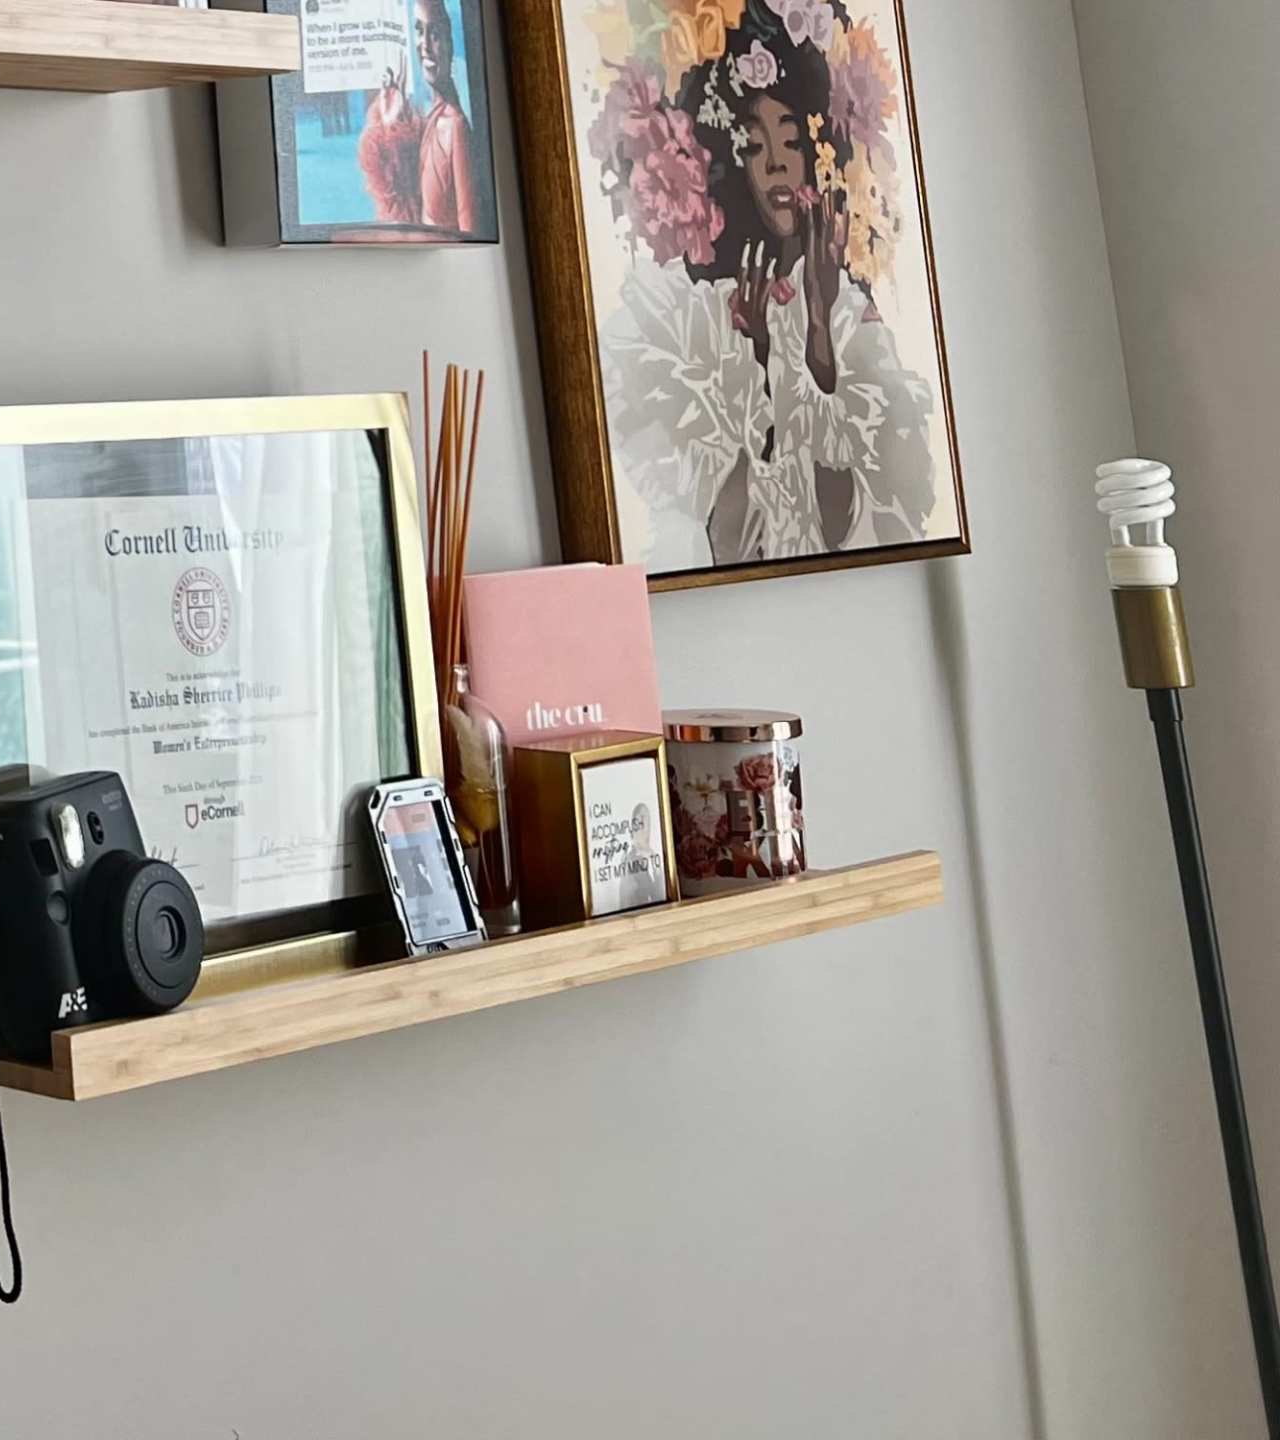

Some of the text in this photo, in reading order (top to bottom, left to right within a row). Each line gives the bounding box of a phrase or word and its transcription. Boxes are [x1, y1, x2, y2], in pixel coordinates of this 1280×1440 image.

[104, 527, 178, 556] Cornell
[526, 702, 561, 731] the
[593, 802, 611, 818] CAN
